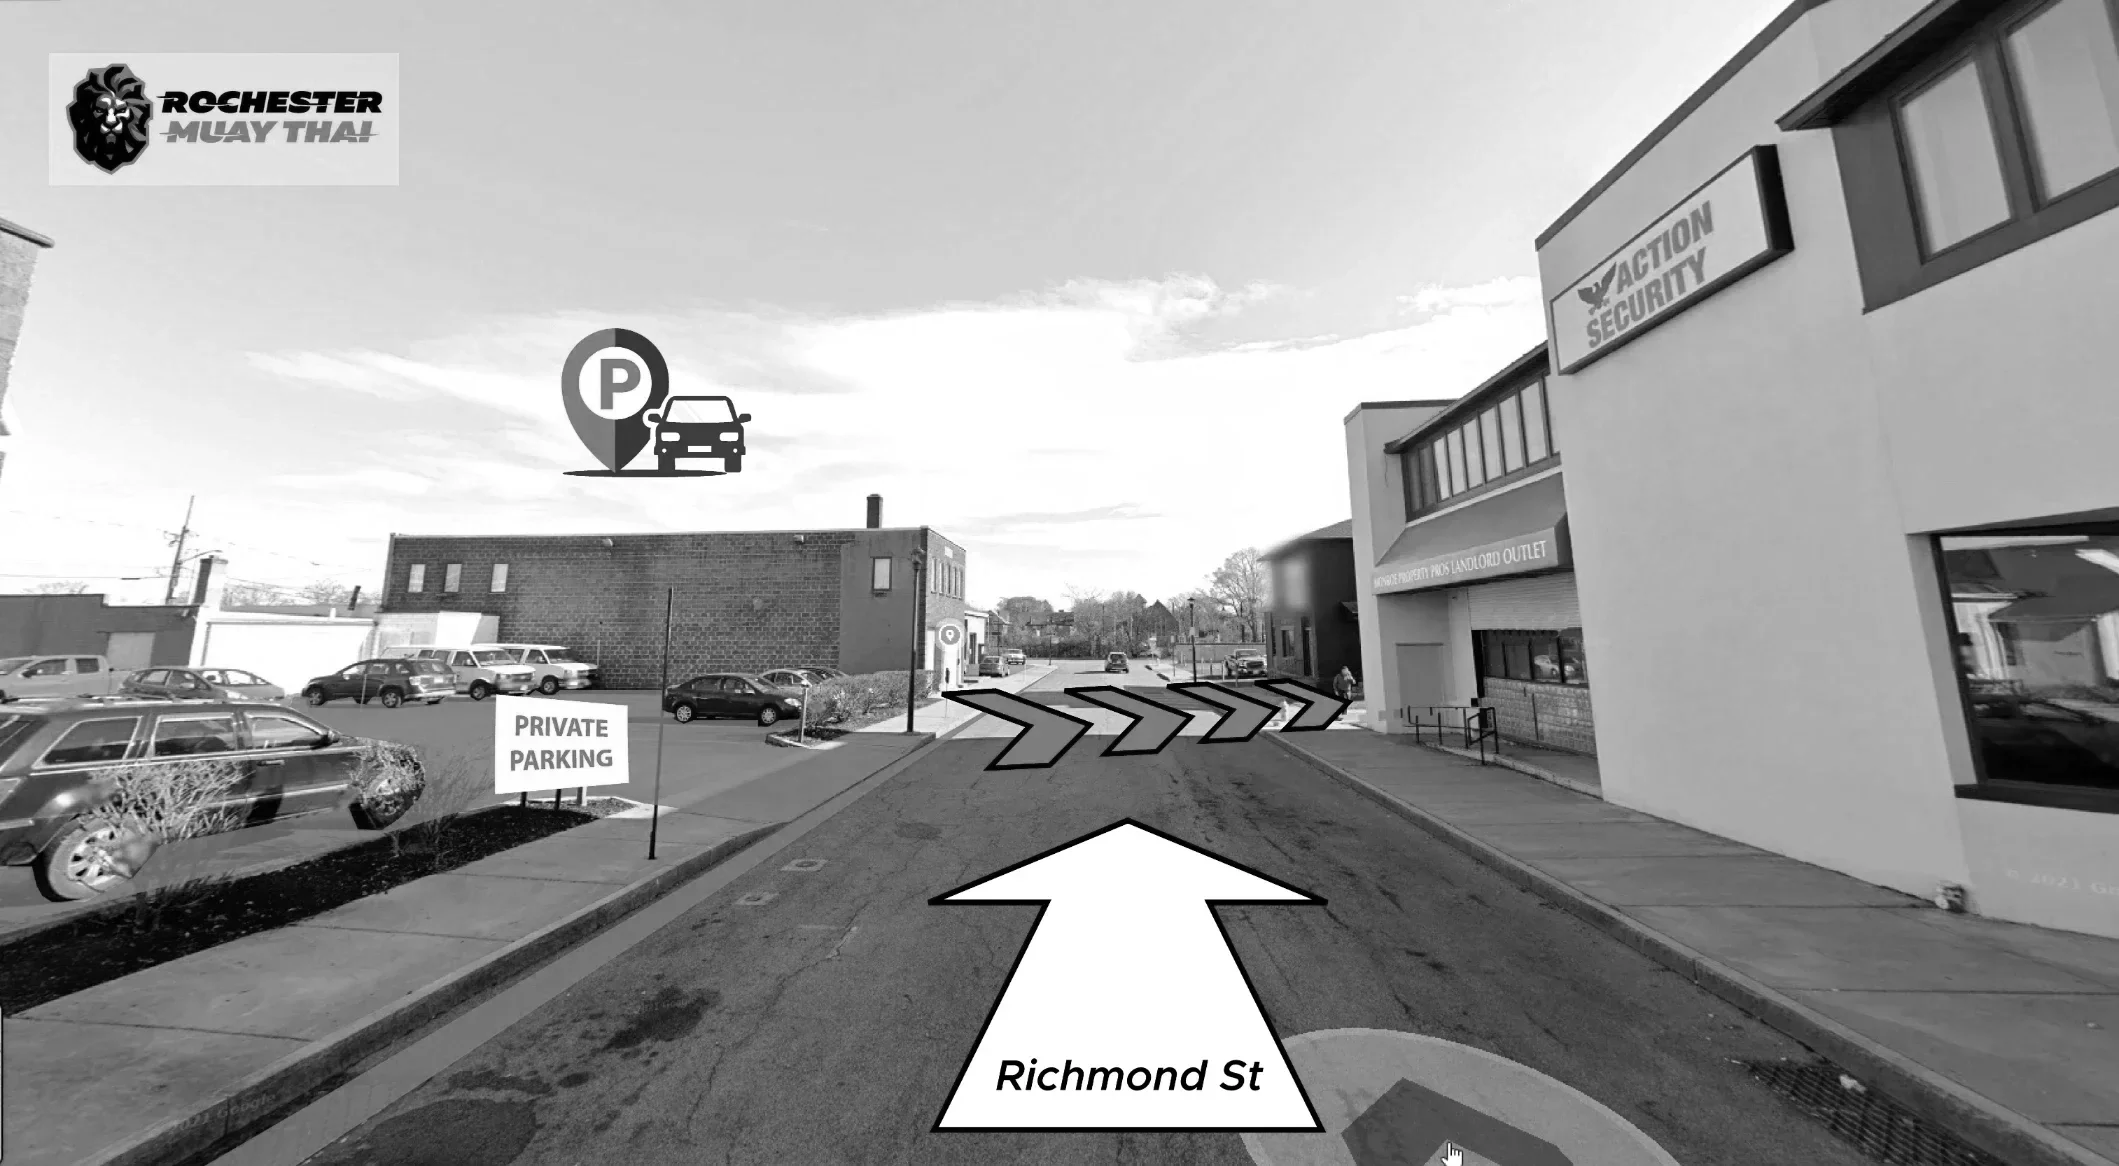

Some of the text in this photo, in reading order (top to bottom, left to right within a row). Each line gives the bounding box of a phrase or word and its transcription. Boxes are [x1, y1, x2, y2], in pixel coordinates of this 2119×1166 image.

[1616, 200, 1713, 294] ACTION
[1586, 246, 1707, 349] SECURITY
[1399, 567, 1430, 584] PROPERTY
[1431, 561, 1450, 578] PROS
[1451, 550, 1501, 575] LANDLORD
[1502, 540, 1548, 565] OUTLET
[515, 715, 608, 738] PRIVATE
[510, 749, 613, 772] PARKING
